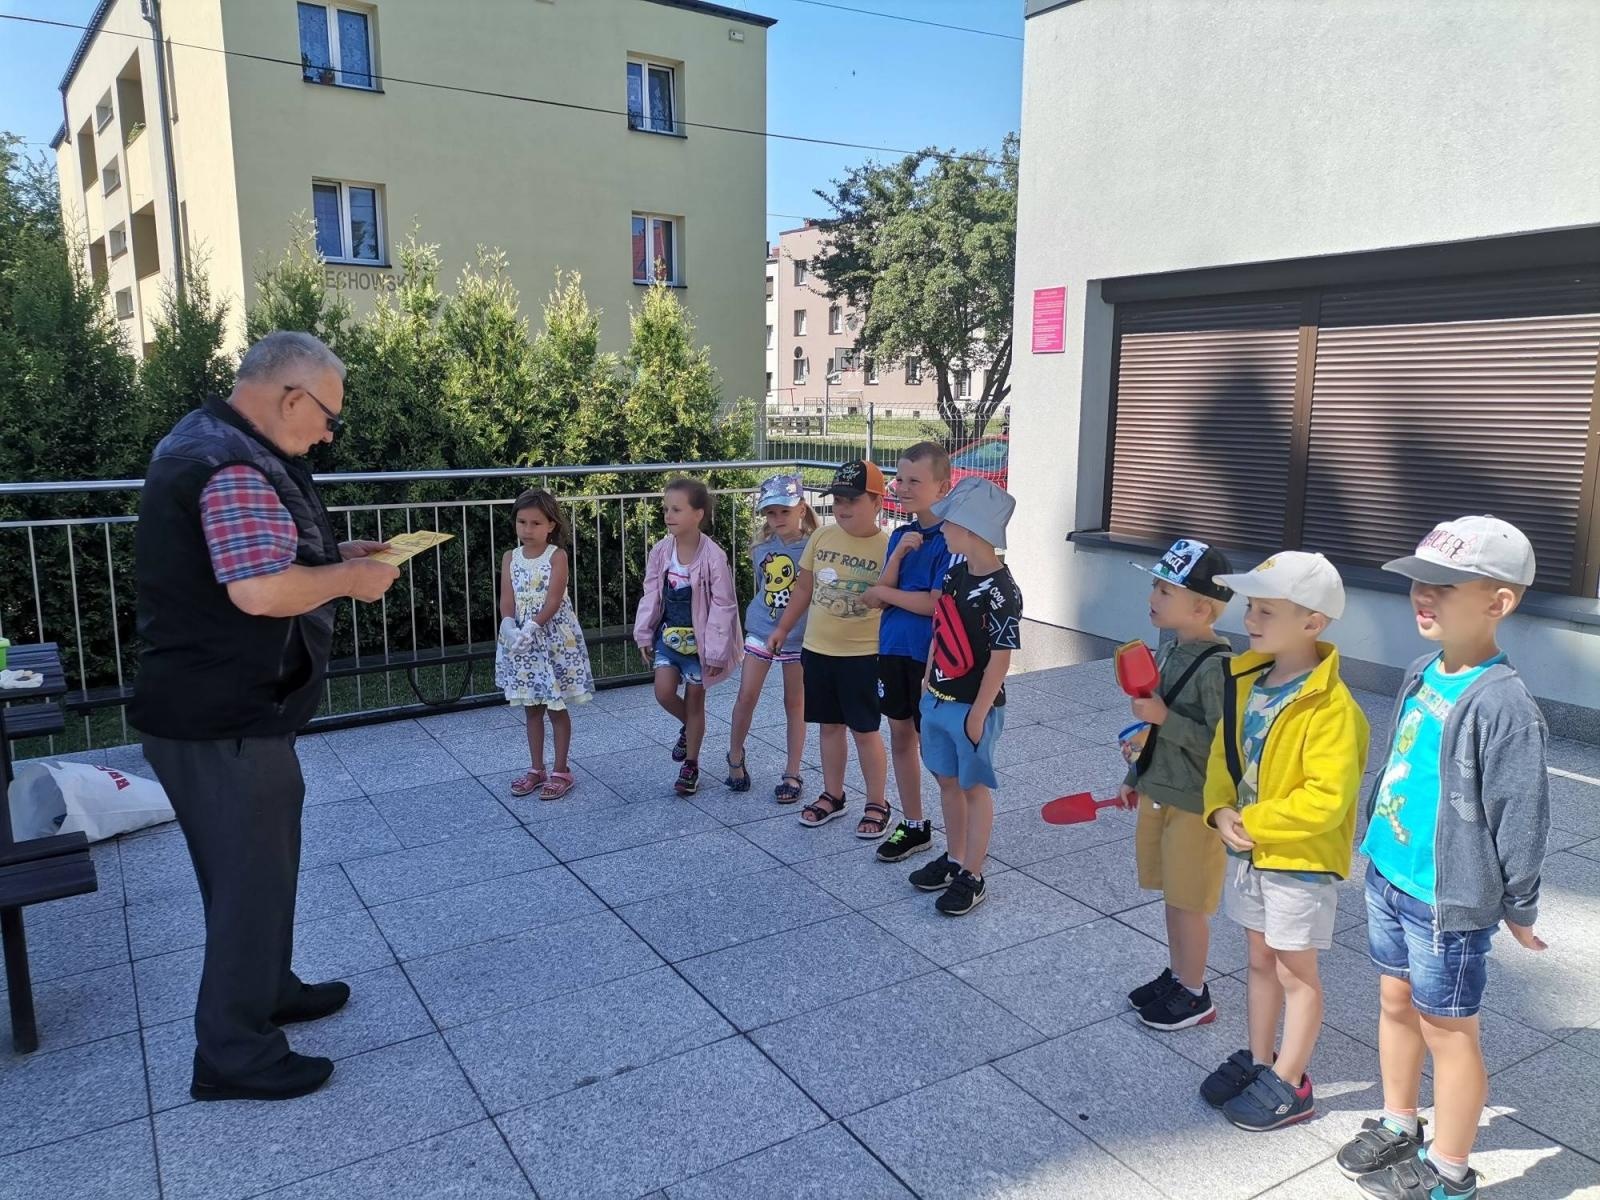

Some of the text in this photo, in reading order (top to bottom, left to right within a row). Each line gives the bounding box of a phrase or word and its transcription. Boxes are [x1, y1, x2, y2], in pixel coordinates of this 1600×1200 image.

[816, 549, 878, 571] OFF ROAD
[989, 587, 1006, 608] COOL
